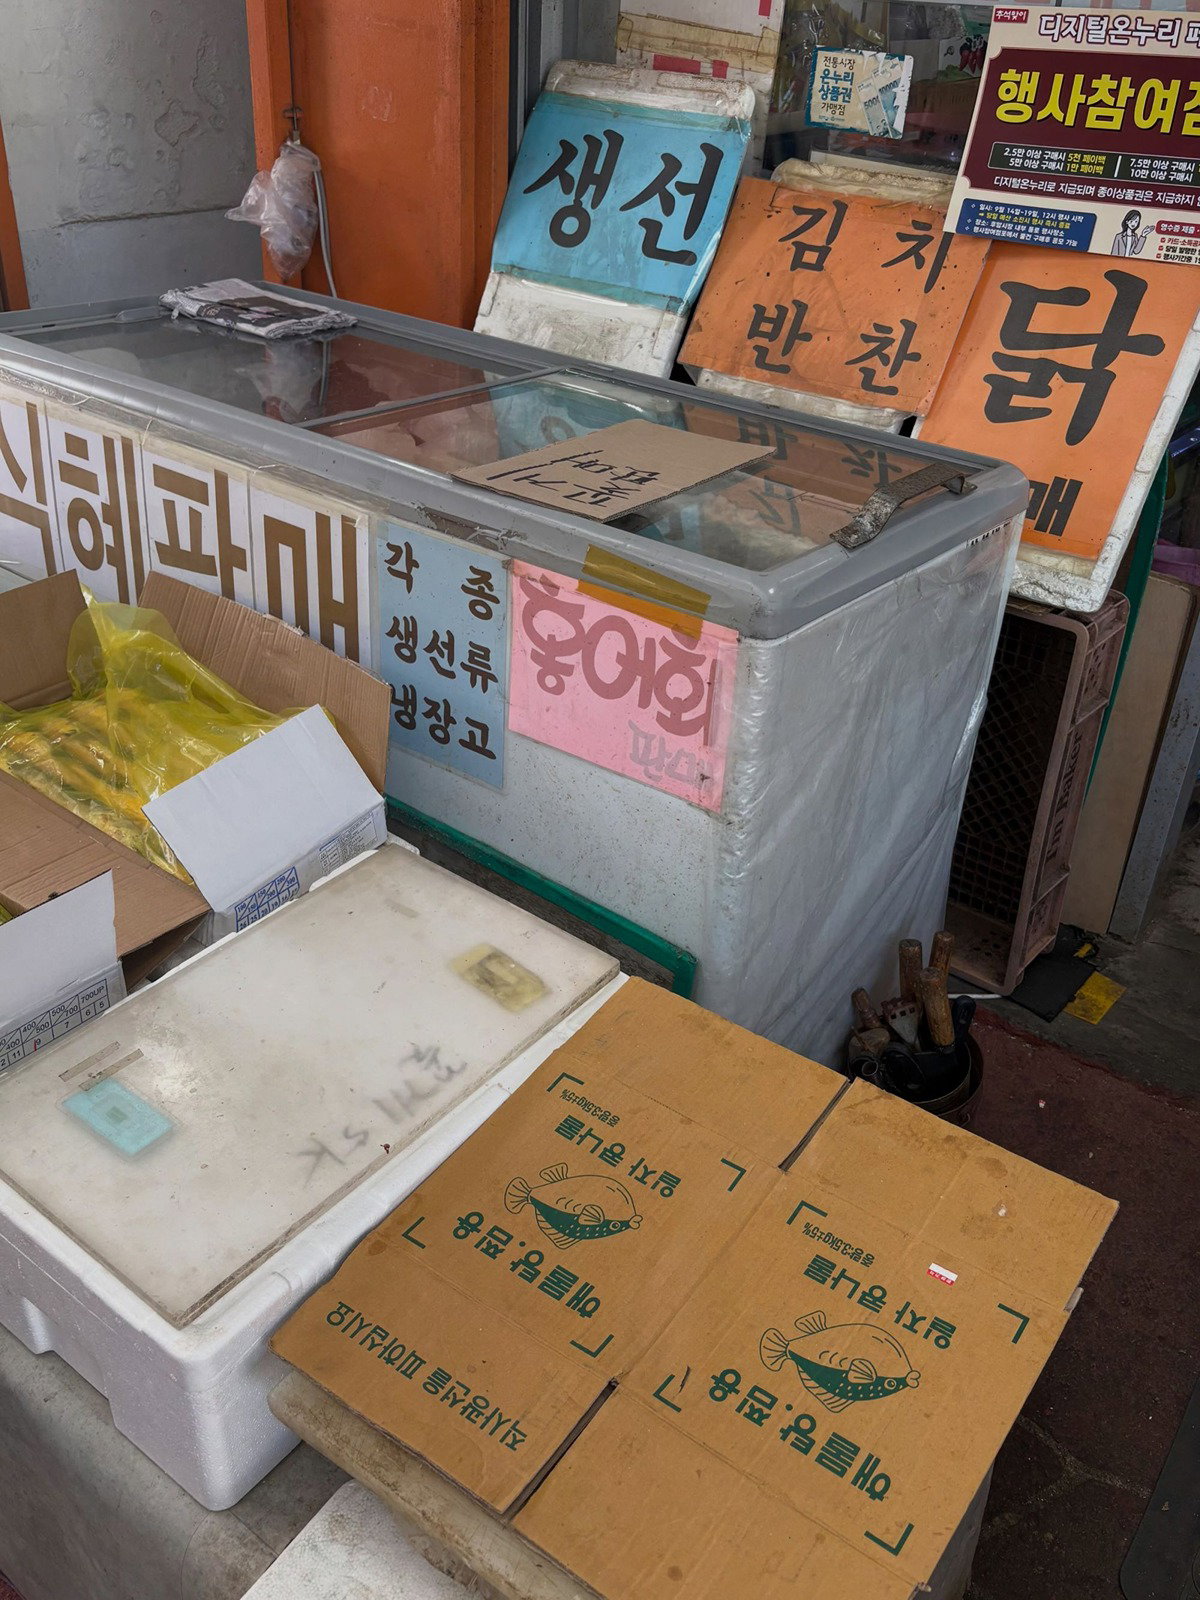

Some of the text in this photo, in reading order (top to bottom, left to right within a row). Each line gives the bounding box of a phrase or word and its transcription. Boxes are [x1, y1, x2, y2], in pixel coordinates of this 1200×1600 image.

[996, 10, 1027, 21] 추석맞이
[1039, 14, 1182, 47] 디지털온누리
[823, 56, 855, 70] 전통시장
[820, 69, 854, 85] 온누리
[818, 85, 852, 103] 상품권
[821, 103, 846, 116] 가맹점
[1004, 148, 1106, 164] 2.5만 이상 구매시 5천 페이백
[1009, 159, 1104, 174] 5만 이상 구매시 1만 페이백
[1130, 158, 1151, 168] 7.5만
[1153, 160, 1169, 170] 이상
[1171, 162, 1196, 172] 구매시
[1131, 169, 1193, 182] 10만 이상 구매시
[522, 129, 724, 266] 생선
[994, 176, 1056, 192] 디지털온누리로
[1058, 183, 1095, 196] 지급되며
[1097, 186, 1154, 202] 종이상품권은
[1155, 192, 1195, 206] 지급하지
[979, 203, 993, 211] 일시:
[1042, 212, 1056, 220] 12시
[1057, 213, 1070, 221] 행사
[1071, 215, 1084, 223] 시작
[1012, 215, 1030, 224] 소진시
[1031, 218, 1044, 226] 행사
[1160, 223, 1195, 234] 영수증 제출
[778, 200, 956, 294] 김치
[1065, 239, 1078, 247] 가능
[747, 299, 922, 396] 반찬
[983, 269, 1166, 446] 닭
[385, 615, 498, 693] 생선류
[520, 573, 717, 747] 홍어회
[391, 684, 497, 760] 냉장고
[81, 985, 104, 1003] 700UP
[52, 1005, 65, 1017] 500
[65, 1005, 78, 1017] 700
[22, 1021, 36, 1033] 400
[36, 1022, 50, 1034] 500
[6, 1039, 20, 1050] 400
[12, 1050, 21, 1059] 11
[561, 1089, 621, 1127] 중량:3.5kg±5%
[554, 1114, 682, 1198] 일자 콩나물
[803, 1221, 876, 1268] 중량:3.5kg±5%
[803, 1254, 957, 1349] 일자 콩나물
[422, 1366, 527, 1451] 직사광선을
